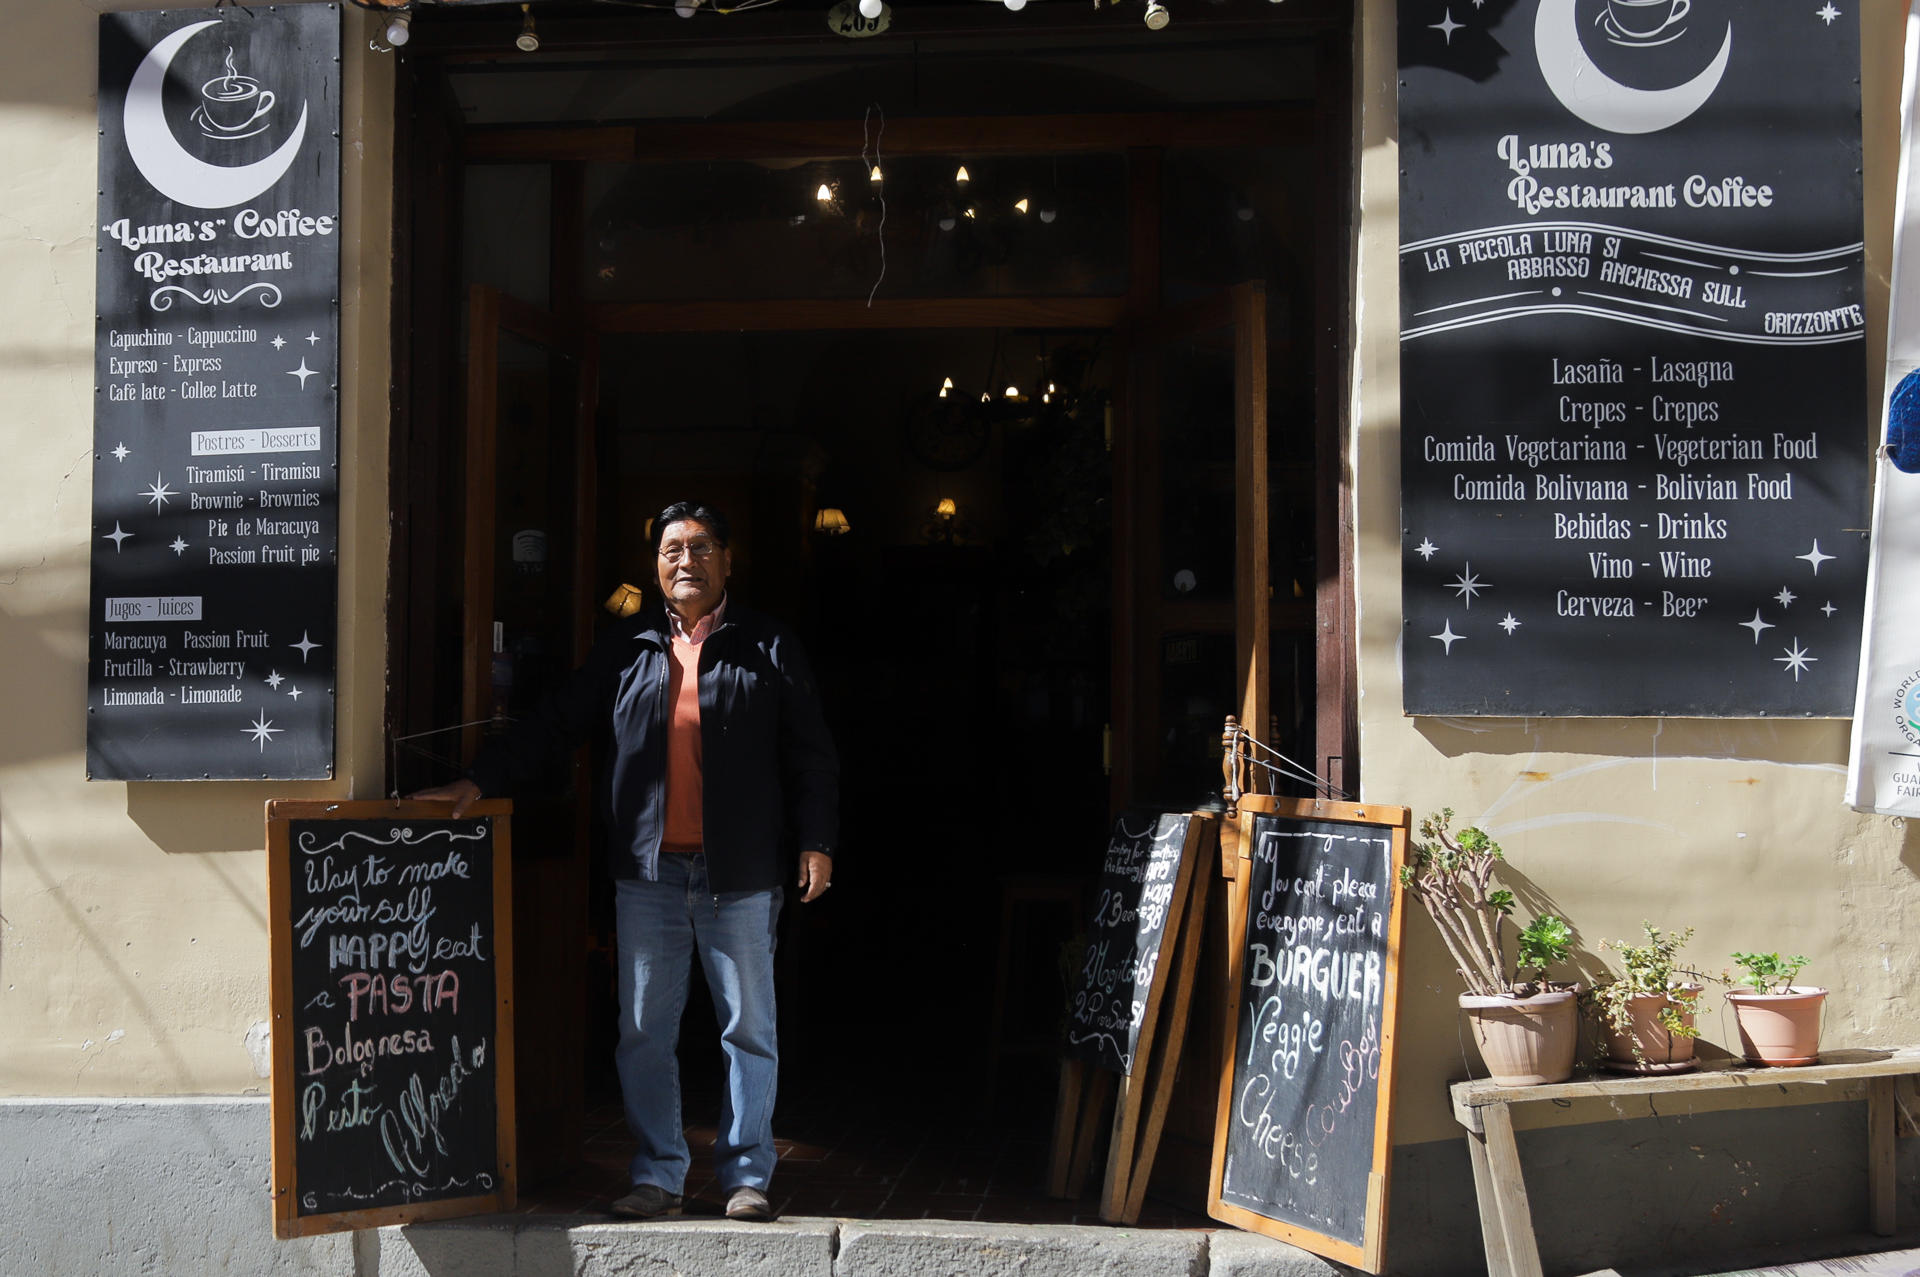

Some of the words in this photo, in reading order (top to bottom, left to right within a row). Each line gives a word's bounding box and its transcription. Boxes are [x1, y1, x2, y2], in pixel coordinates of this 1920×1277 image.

[1497, 134, 1613, 177] Luna's
[1507, 174, 1677, 215] Restaurant
[1683, 174, 1773, 208] Coffee
[233, 208, 333, 239] Coffee
[133, 250, 293, 283] Restaurant
[1424, 248, 1450, 272] LA
[1459, 233, 1533, 265] PICCOLA
[1543, 231, 1593, 255] LUNA
[1602, 236, 1621, 259] SI
[1507, 256, 1590, 281] ABBASSO
[1600, 260, 1693, 299] ANCHESSA
[1702, 281, 1747, 309] SULL
[1764, 304, 1865, 335] ORIZZONTE
[110, 328, 173, 352] Capuchino
[188, 325, 257, 348] Cappuccino
[110, 356, 158, 378] Expreso
[173, 354, 222, 376] Express
[1552, 358, 1624, 385] Lasaña
[1651, 356, 1735, 388] Lasagna
[141, 382, 166, 400] late
[222, 380, 257, 398] Latte
[1559, 395, 1626, 429] Crepes
[1652, 395, 1719, 428] Crepes
[197, 433, 245, 451] Postres
[261, 431, 317, 449] Desserts
[1424, 434, 1496, 462] Comida
[1505, 434, 1627, 468] Vegetariana
[1654, 433, 1764, 467] Vegeterian
[1773, 432, 1819, 459] Food
[261, 462, 321, 481] Tiramisu
[1454, 473, 1526, 501] Comida
[1535, 473, 1629, 501] Boliviana
[1656, 473, 1738, 500] Bolivian
[1747, 472, 1792, 500] Food
[191, 490, 244, 510] Brownie
[260, 489, 320, 508] Brownies
[208, 519, 228, 537] Pie
[236, 518, 251, 536] de
[256, 518, 320, 539] Maracuya
[1554, 512, 1631, 540] Bebidas
[1657, 512, 1727, 540] Drinks
[209, 546, 256, 565] Passion
[262, 545, 296, 563] fruit
[301, 544, 320, 567] pie
[1588, 552, 1633, 579] Vino
[1659, 551, 1712, 578] Wine
[109, 599, 142, 620] Jugos
[157, 598, 194, 617] Juices
[1557, 589, 1635, 617] Cerveza
[1662, 590, 1708, 618] Beer
[104, 632, 167, 654] Maracuya
[184, 630, 230, 649] Passion
[236, 630, 270, 648] Fruit
[104, 658, 153, 677] Frutilla
[169, 657, 245, 680] Strawberry
[103, 687, 164, 706] Limonada
[181, 684, 242, 704] Limonade
[1893, 772, 1920, 785] GUA
[363, 854, 396, 888] to
[398, 850, 471, 885] make
[1336, 904, 1366, 935] eat
[1371, 912, 1382, 938] a
[433, 921, 486, 961] eat
[1250, 942, 1381, 1006] BURGUER
[338, 969, 460, 1022] PASTA
[1248, 995, 1324, 1080] Veggie
[300, 1078, 383, 1142] Pesto
[1240, 1073, 1318, 1186] Cheese
